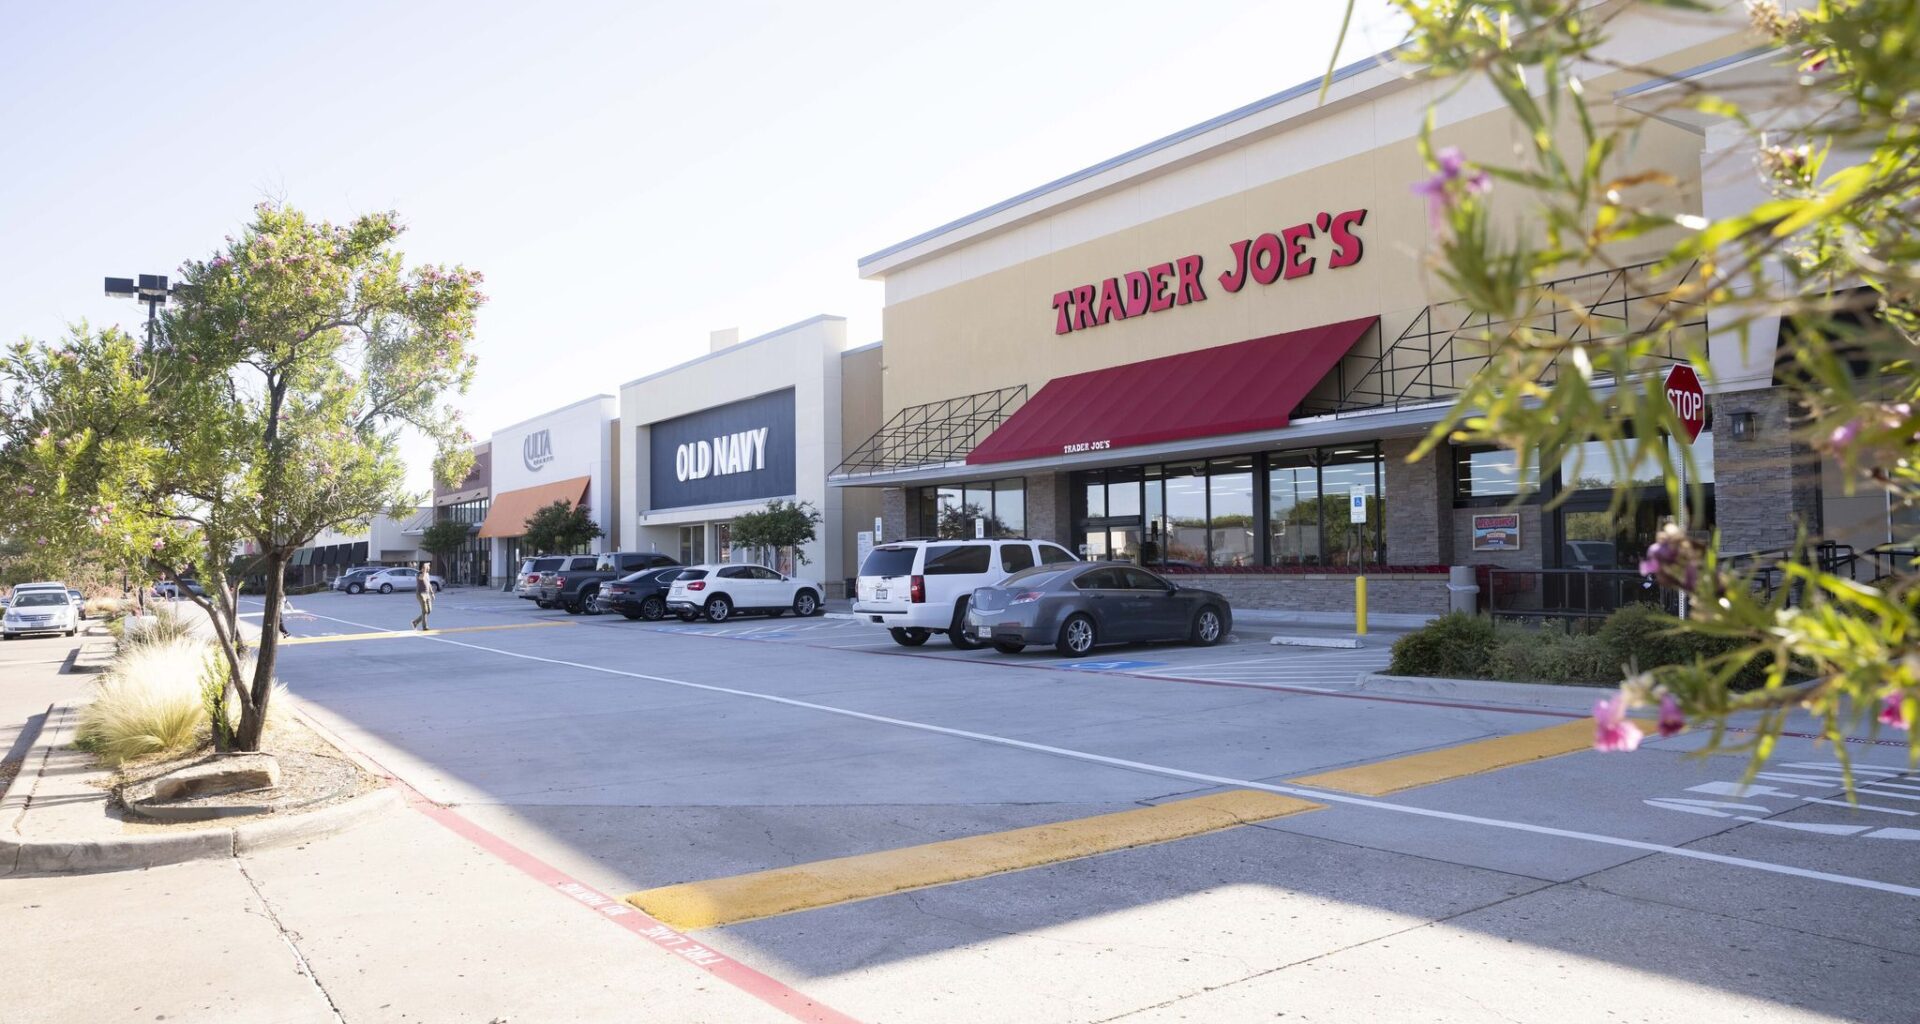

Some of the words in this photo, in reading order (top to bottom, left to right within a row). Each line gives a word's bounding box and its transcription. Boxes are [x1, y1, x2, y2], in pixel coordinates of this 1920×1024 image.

[1052, 254, 1207, 335] TRADER
[1217, 208, 1368, 293] JOE'S
[1667, 388, 1702, 421] STOP
[527, 429, 552, 460] ULTA
[676, 440, 713, 482] OLD
[713, 427, 768, 477] NAVY
[1063, 443, 1090, 454] TRADER
[1091, 440, 1111, 450] JOE'S
[639, 925, 688, 946] LANE
[675, 945, 724, 966] FIRE
